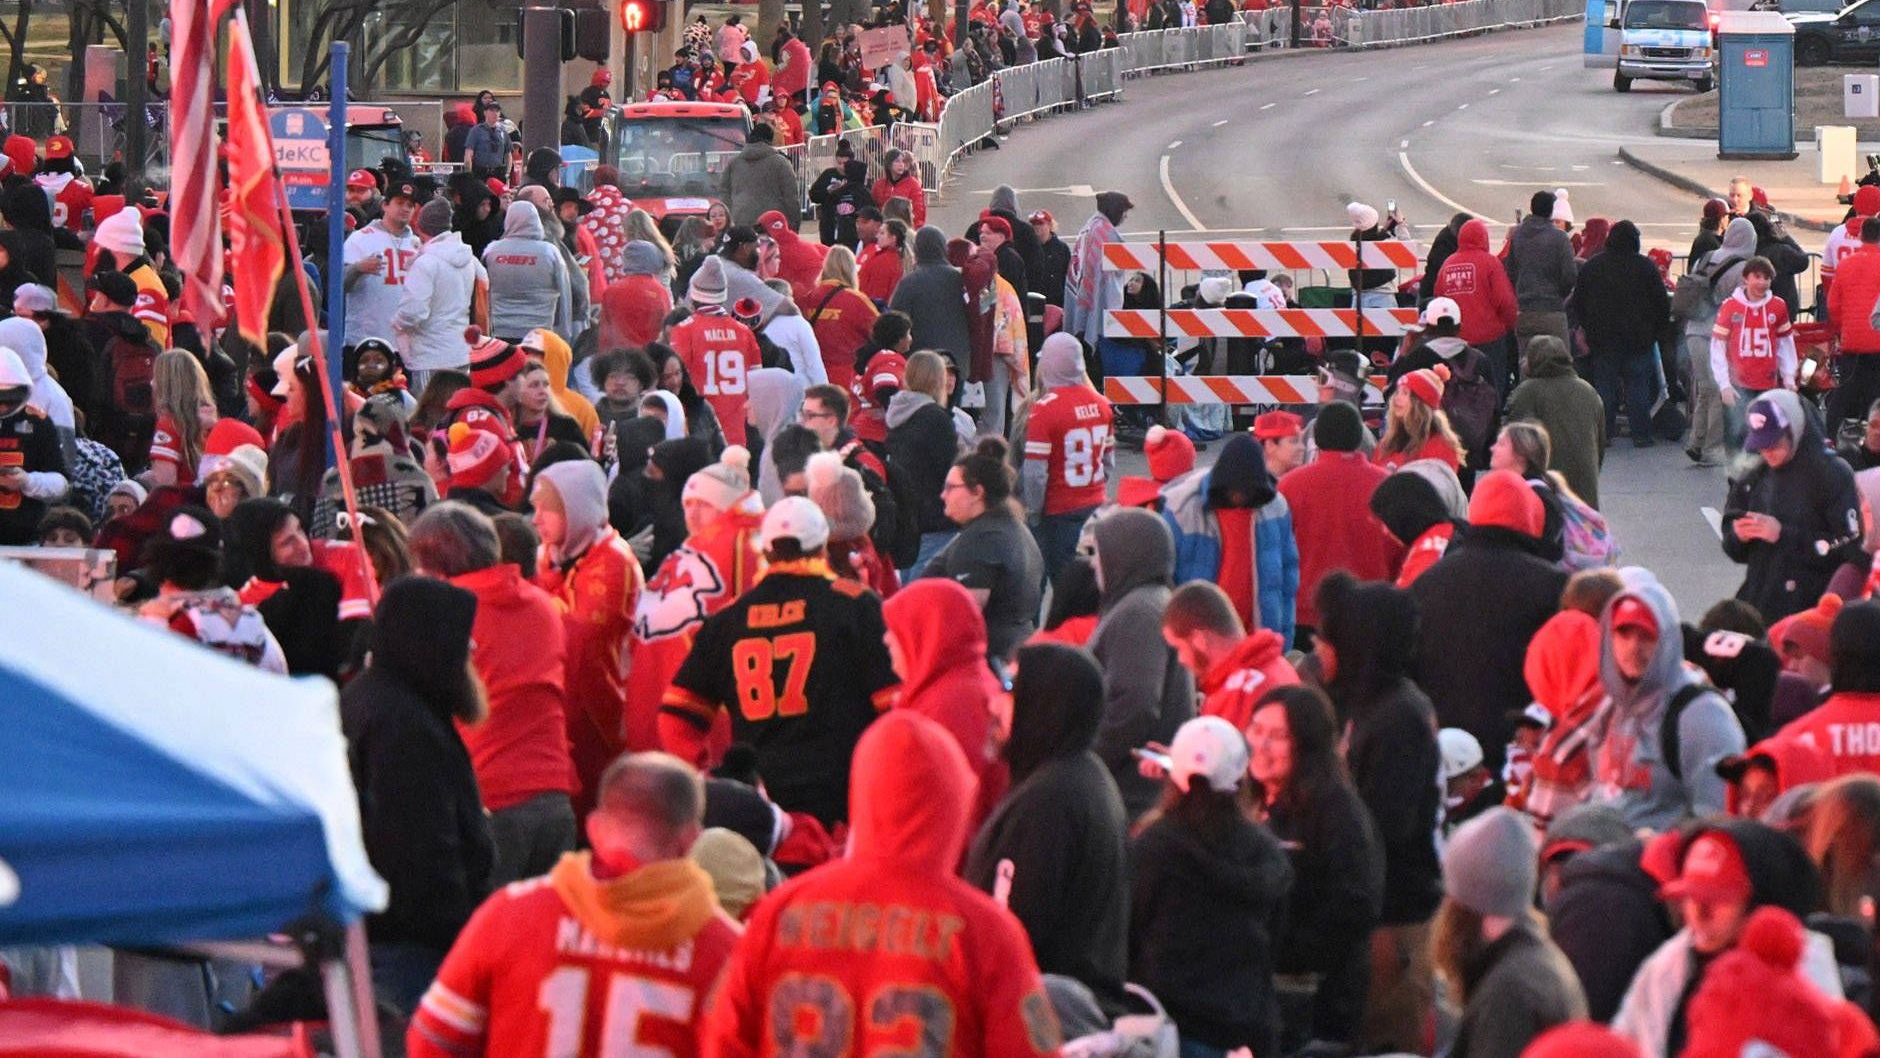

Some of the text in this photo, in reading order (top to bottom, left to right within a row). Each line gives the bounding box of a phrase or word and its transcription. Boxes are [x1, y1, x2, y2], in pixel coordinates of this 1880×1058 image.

[495, 254, 538, 265] CHIEFS
[1740, 327, 1771, 358] 15
[703, 350, 746, 396] 19
[1064, 425, 1109, 488] 87
[733, 632, 817, 722] 87
[538, 965, 697, 1058] 15
